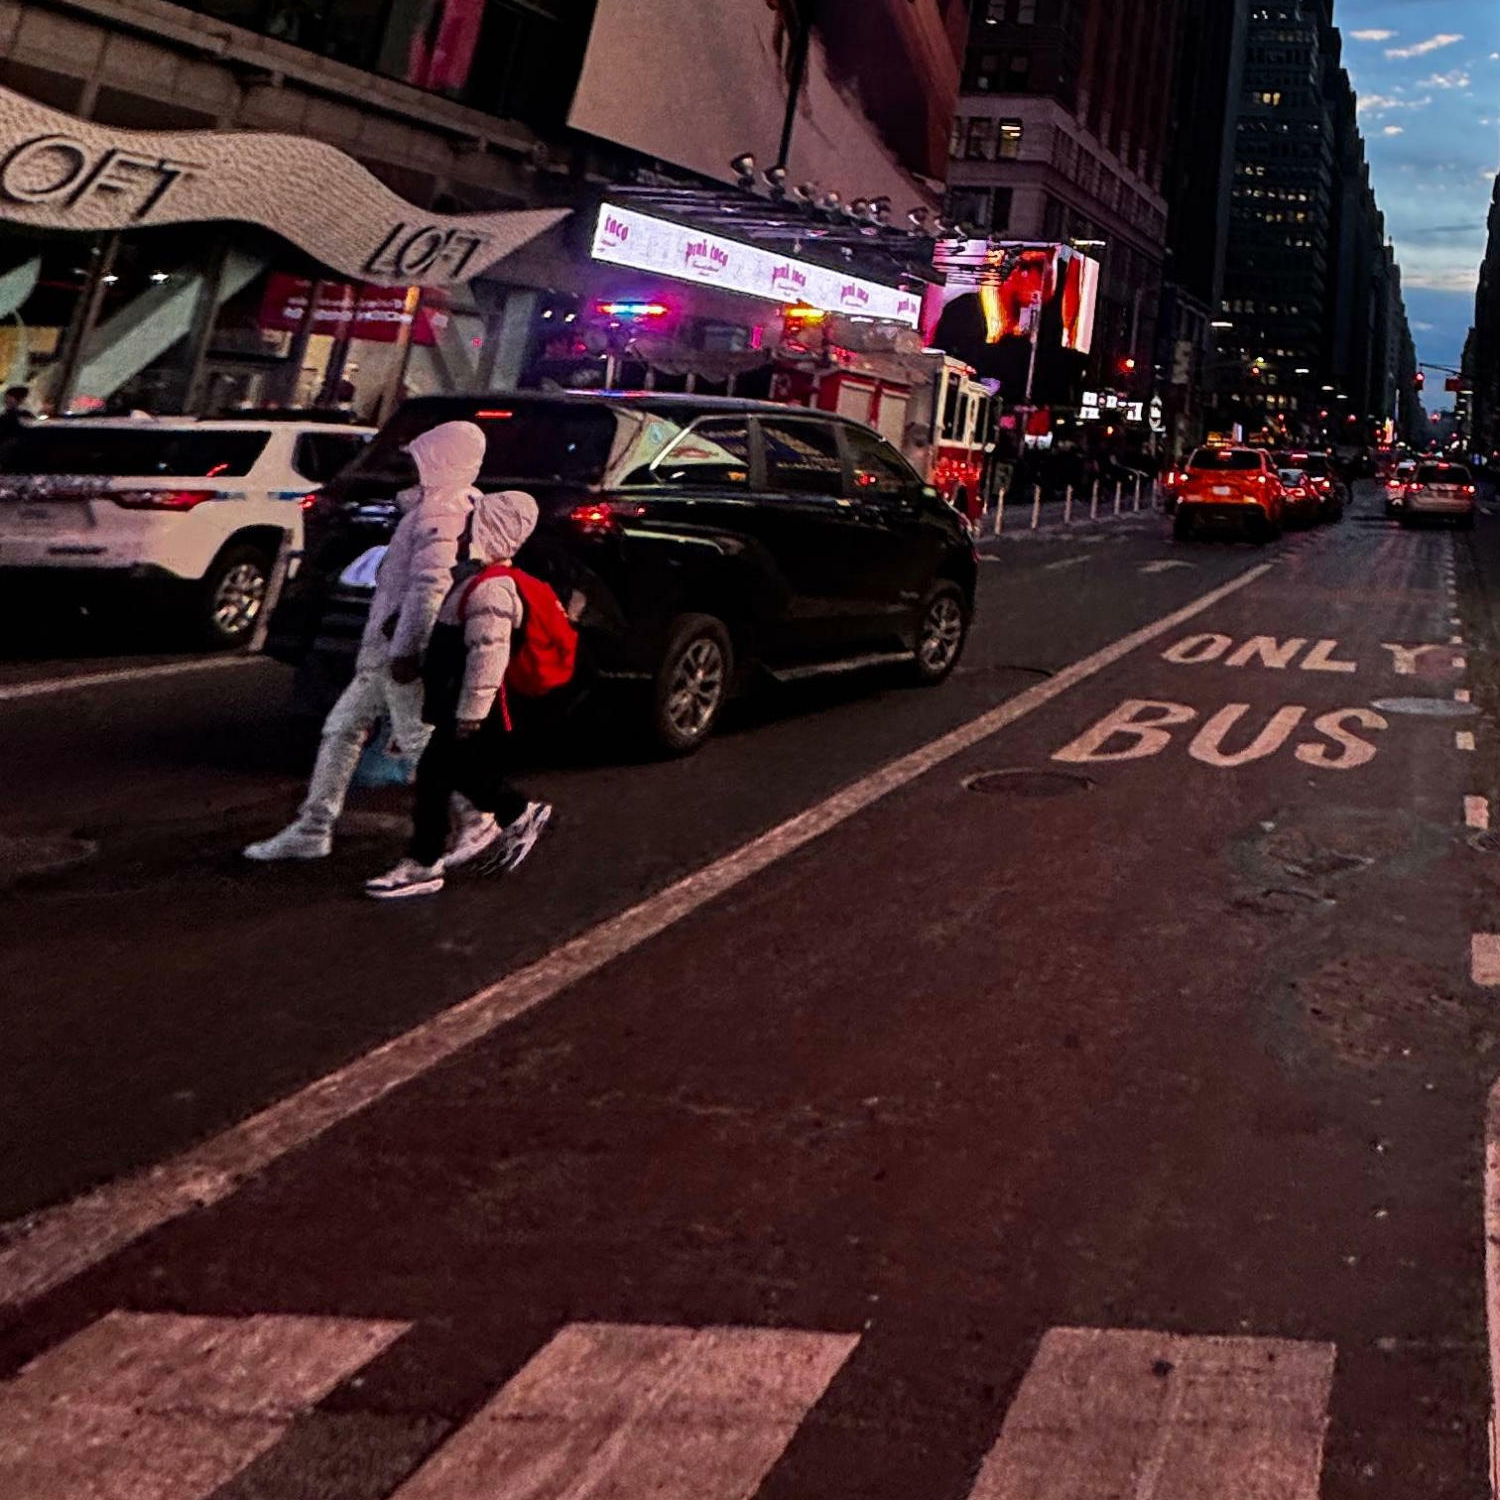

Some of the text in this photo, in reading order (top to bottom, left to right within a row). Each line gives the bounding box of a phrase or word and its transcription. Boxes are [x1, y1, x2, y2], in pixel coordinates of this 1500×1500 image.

[361, 222, 492, 278] LOFT
[1161, 632, 1447, 675] ONLY
[1051, 699, 1389, 770] BUS
